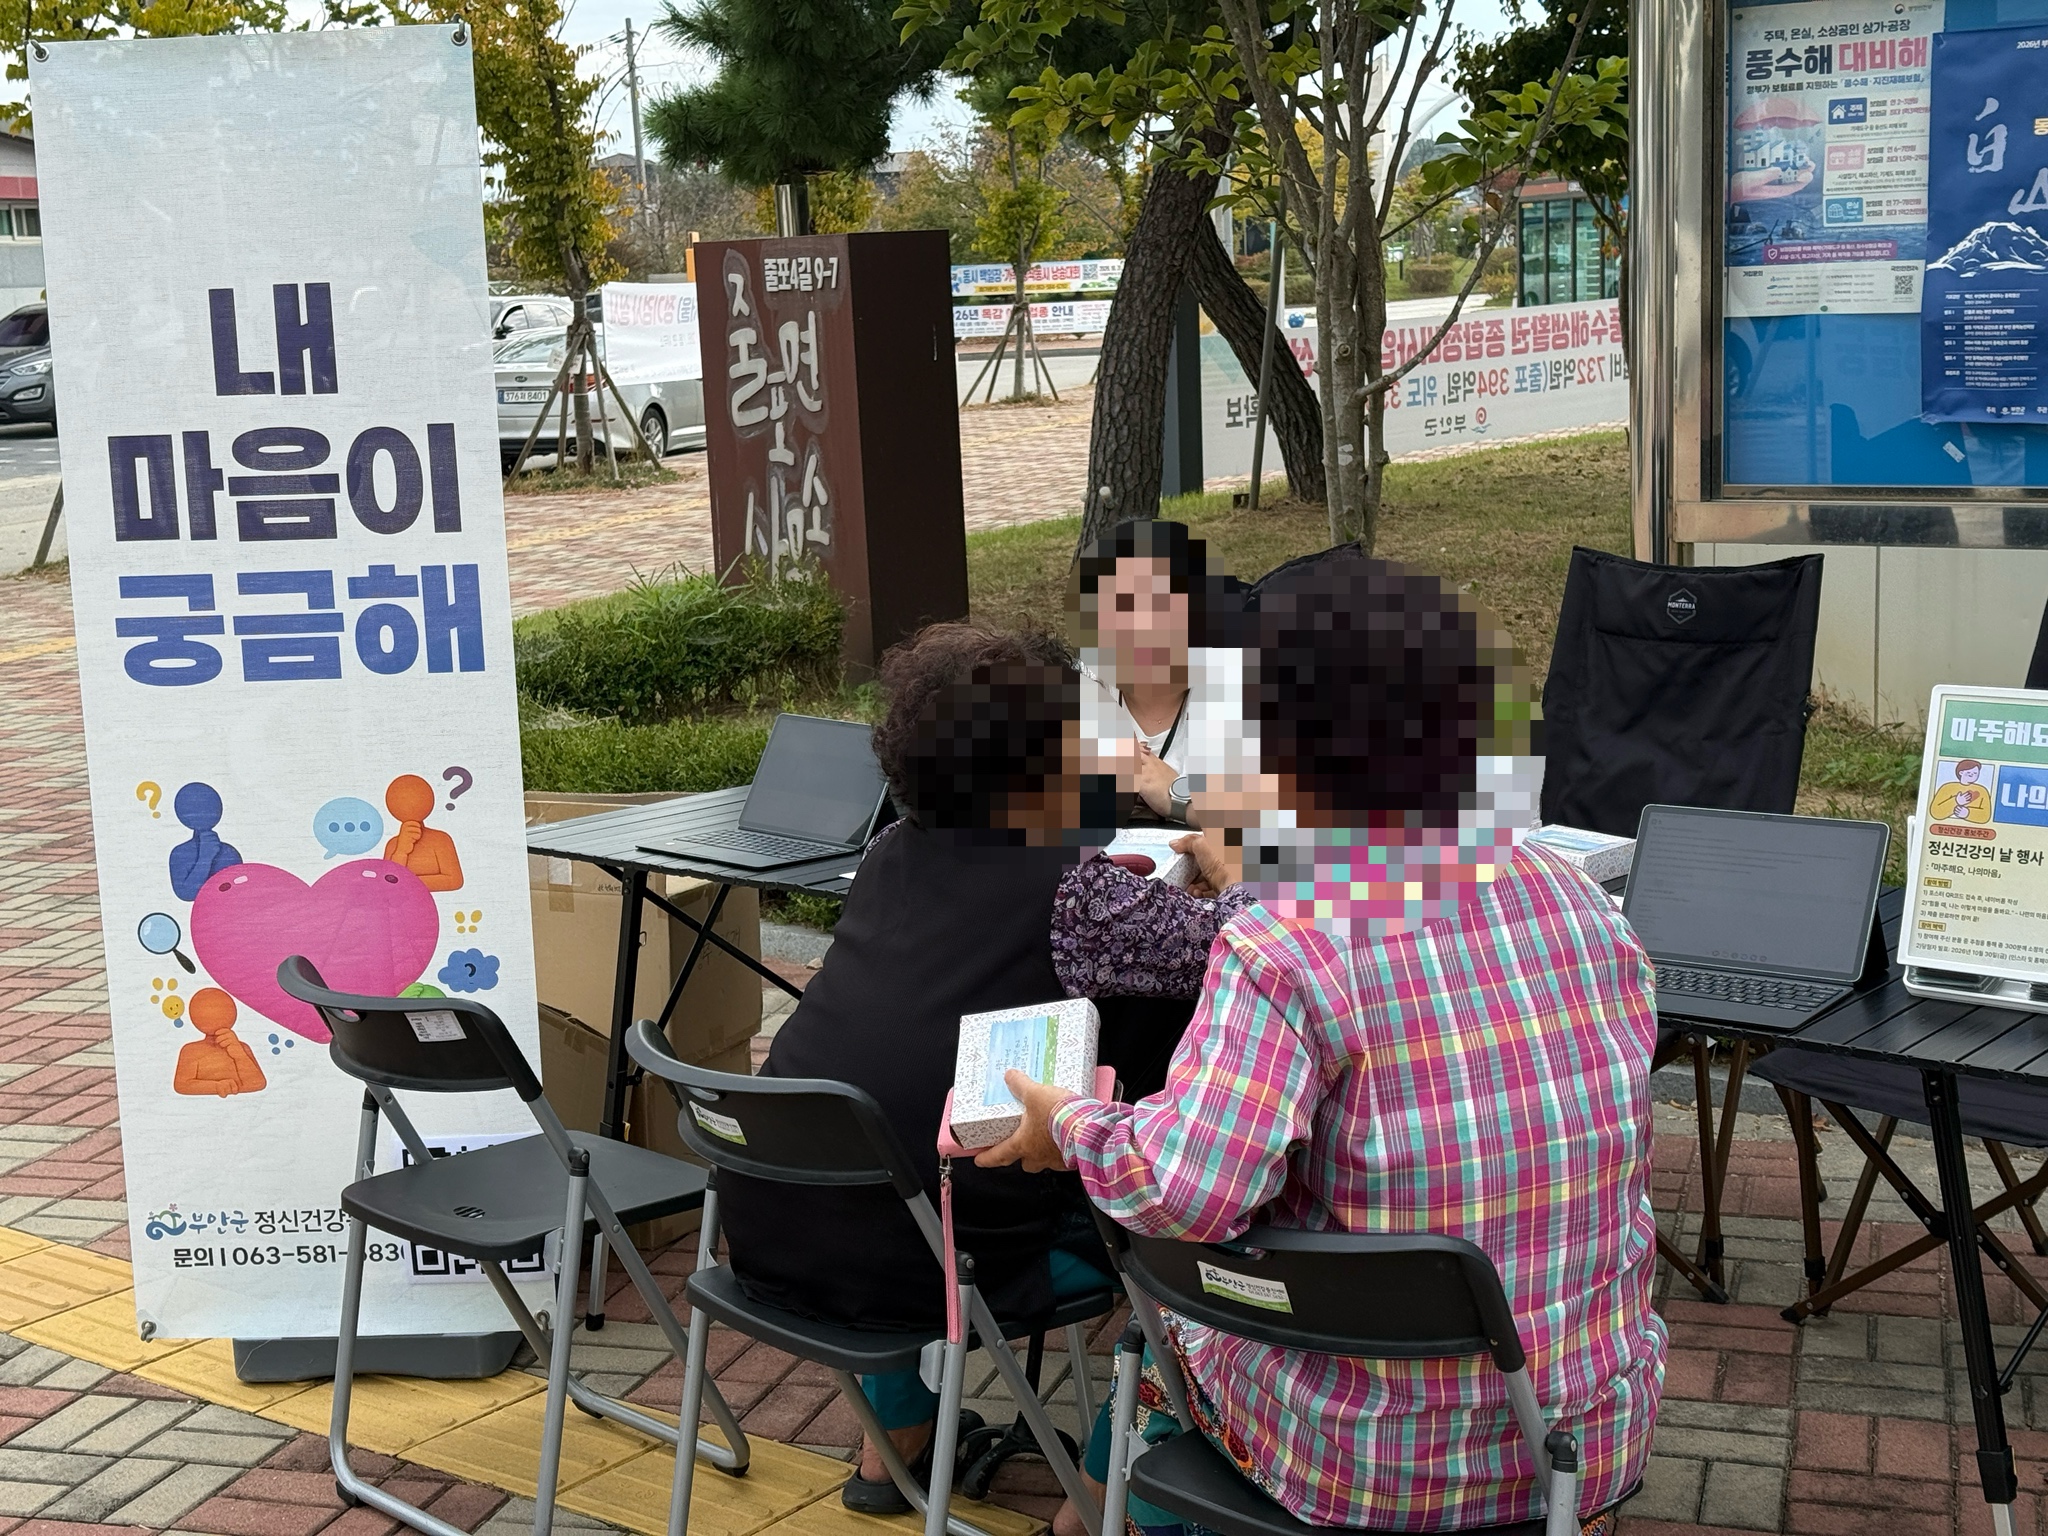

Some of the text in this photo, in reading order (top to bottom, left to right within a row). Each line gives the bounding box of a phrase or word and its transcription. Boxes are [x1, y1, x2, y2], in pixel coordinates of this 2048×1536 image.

[1764, 30, 1787, 43] 주택,
[1790, 28, 1815, 40] 온실,
[1817, 23, 1859, 38] 소상공인
[1746, 36, 1928, 81] 풍수해 대비해
[1805, 81, 1838, 91] 지원하는
[764, 256, 838, 292] 줄포4길 9-7
[1052, 306, 1074, 318] 안내
[209, 281, 338, 396] 내
[528, 392, 546, 400] 8401
[108, 422, 462, 542] 마음이
[115, 563, 486, 687] 궁금해
[1938, 826, 1990, 838] 정신건강 홍보주간
[1928, 840, 2044, 866] 정신건강의 날 행사
[188, 1213, 250, 1235] 부안군
[173, 1247, 214, 1268] 문의
[232, 1243, 405, 1267] 063-581-83
